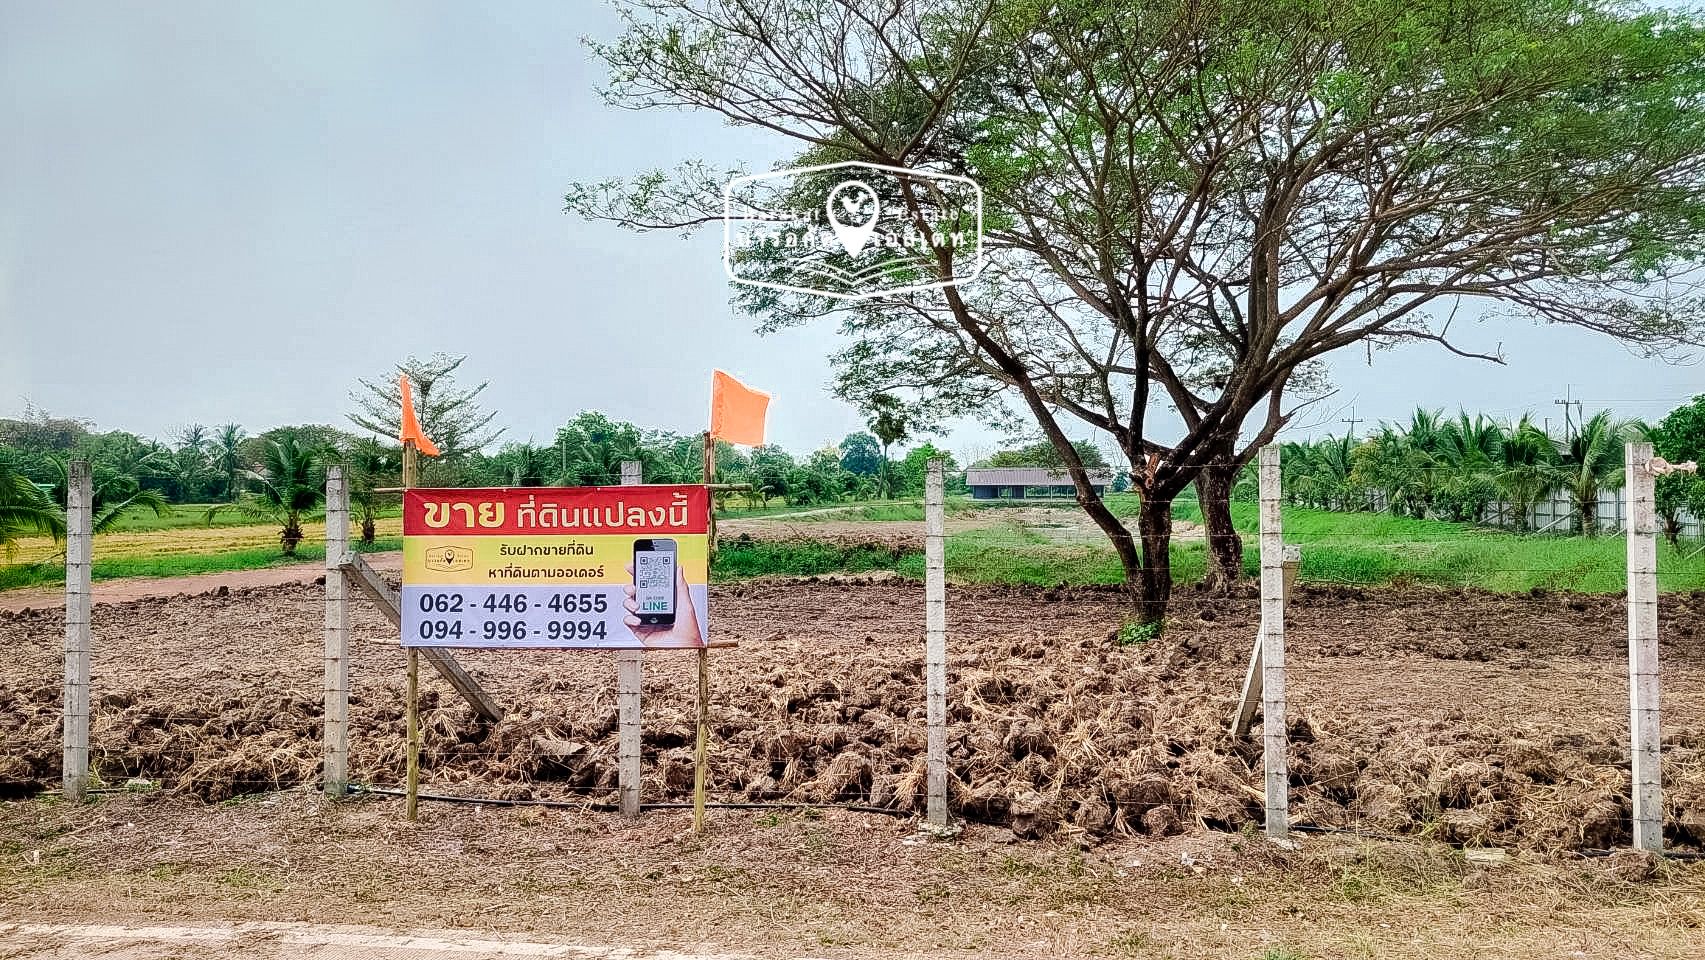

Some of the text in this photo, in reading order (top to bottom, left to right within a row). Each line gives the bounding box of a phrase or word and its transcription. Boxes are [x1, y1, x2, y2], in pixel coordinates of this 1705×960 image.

[424, 492, 688, 528] ขาย ที่ดินแปลงนี้
[499, 539, 594, 556] รับฝากขายที่ดิน
[488, 562, 605, 578] หาที่ดินตามออเดอร์
[419, 593, 464, 613] 062
[482, 593, 528, 613] 446
[547, 593, 608, 613] 4655
[642, 601, 668, 610] LINE
[419, 620, 463, 640] 094
[482, 620, 527, 640] 996
[547, 620, 608, 640] 9994
